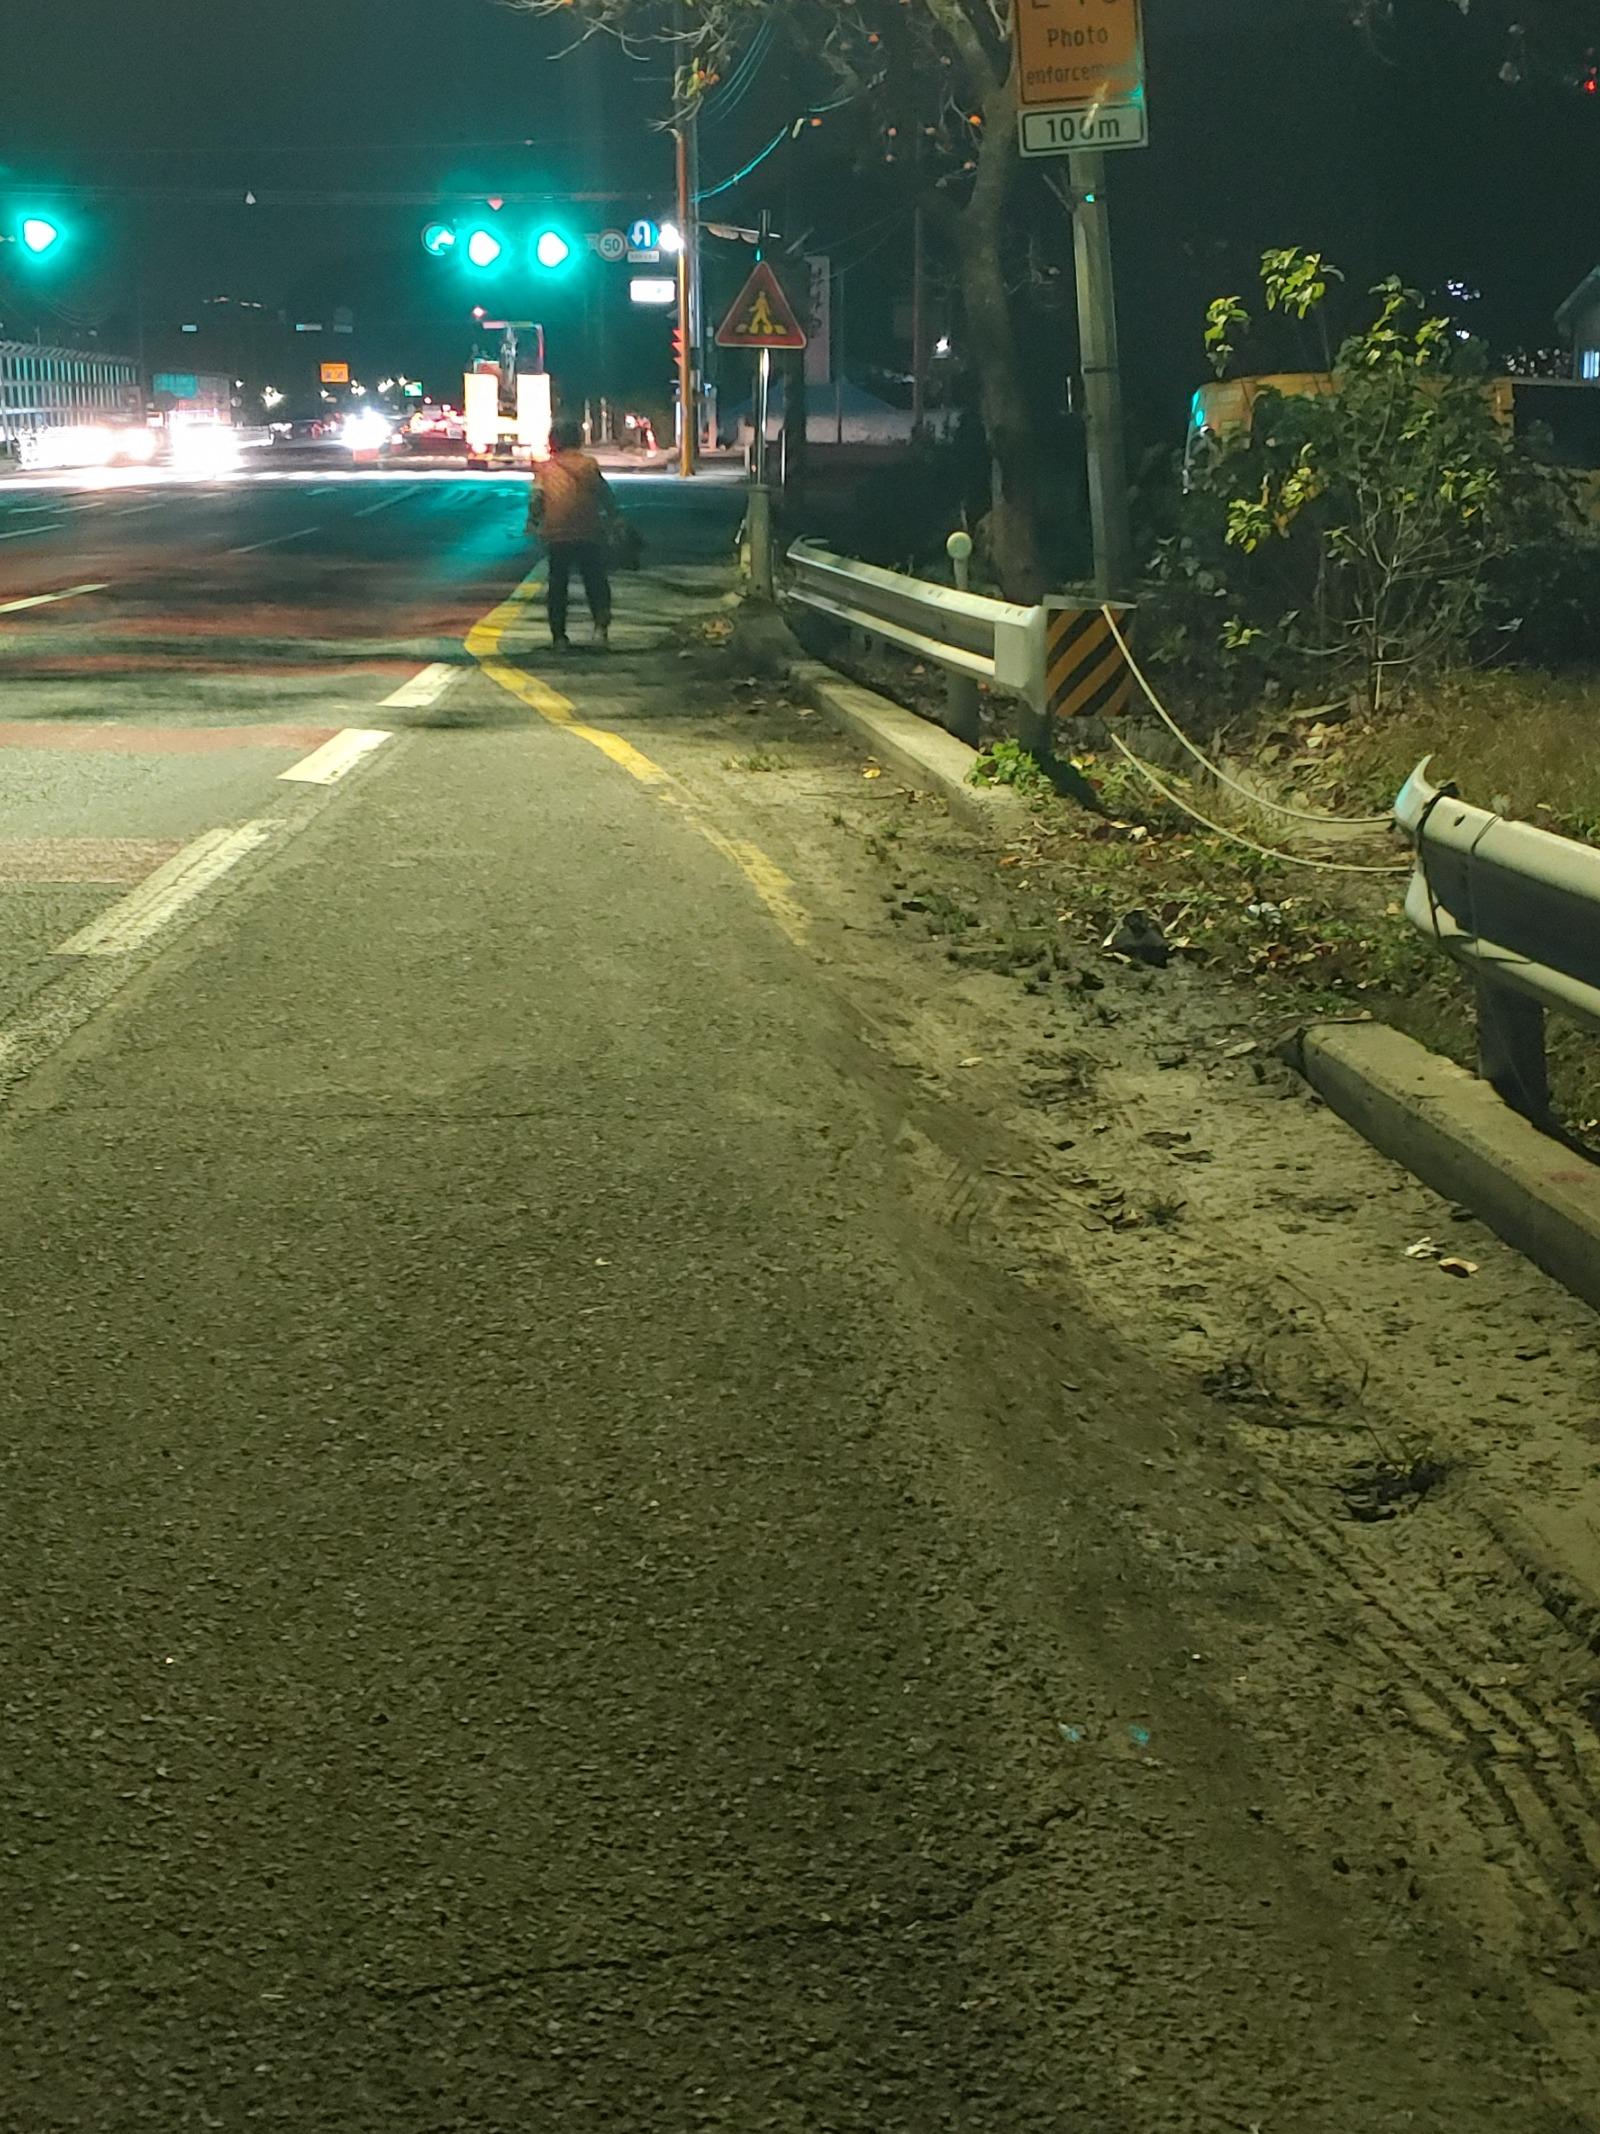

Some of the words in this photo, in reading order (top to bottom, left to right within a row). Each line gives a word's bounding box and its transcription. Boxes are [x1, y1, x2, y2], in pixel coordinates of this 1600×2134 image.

[1047, 26, 1109, 48] Photo
[1046, 116, 1120, 143] 100m
[603, 238, 621, 252] 50
